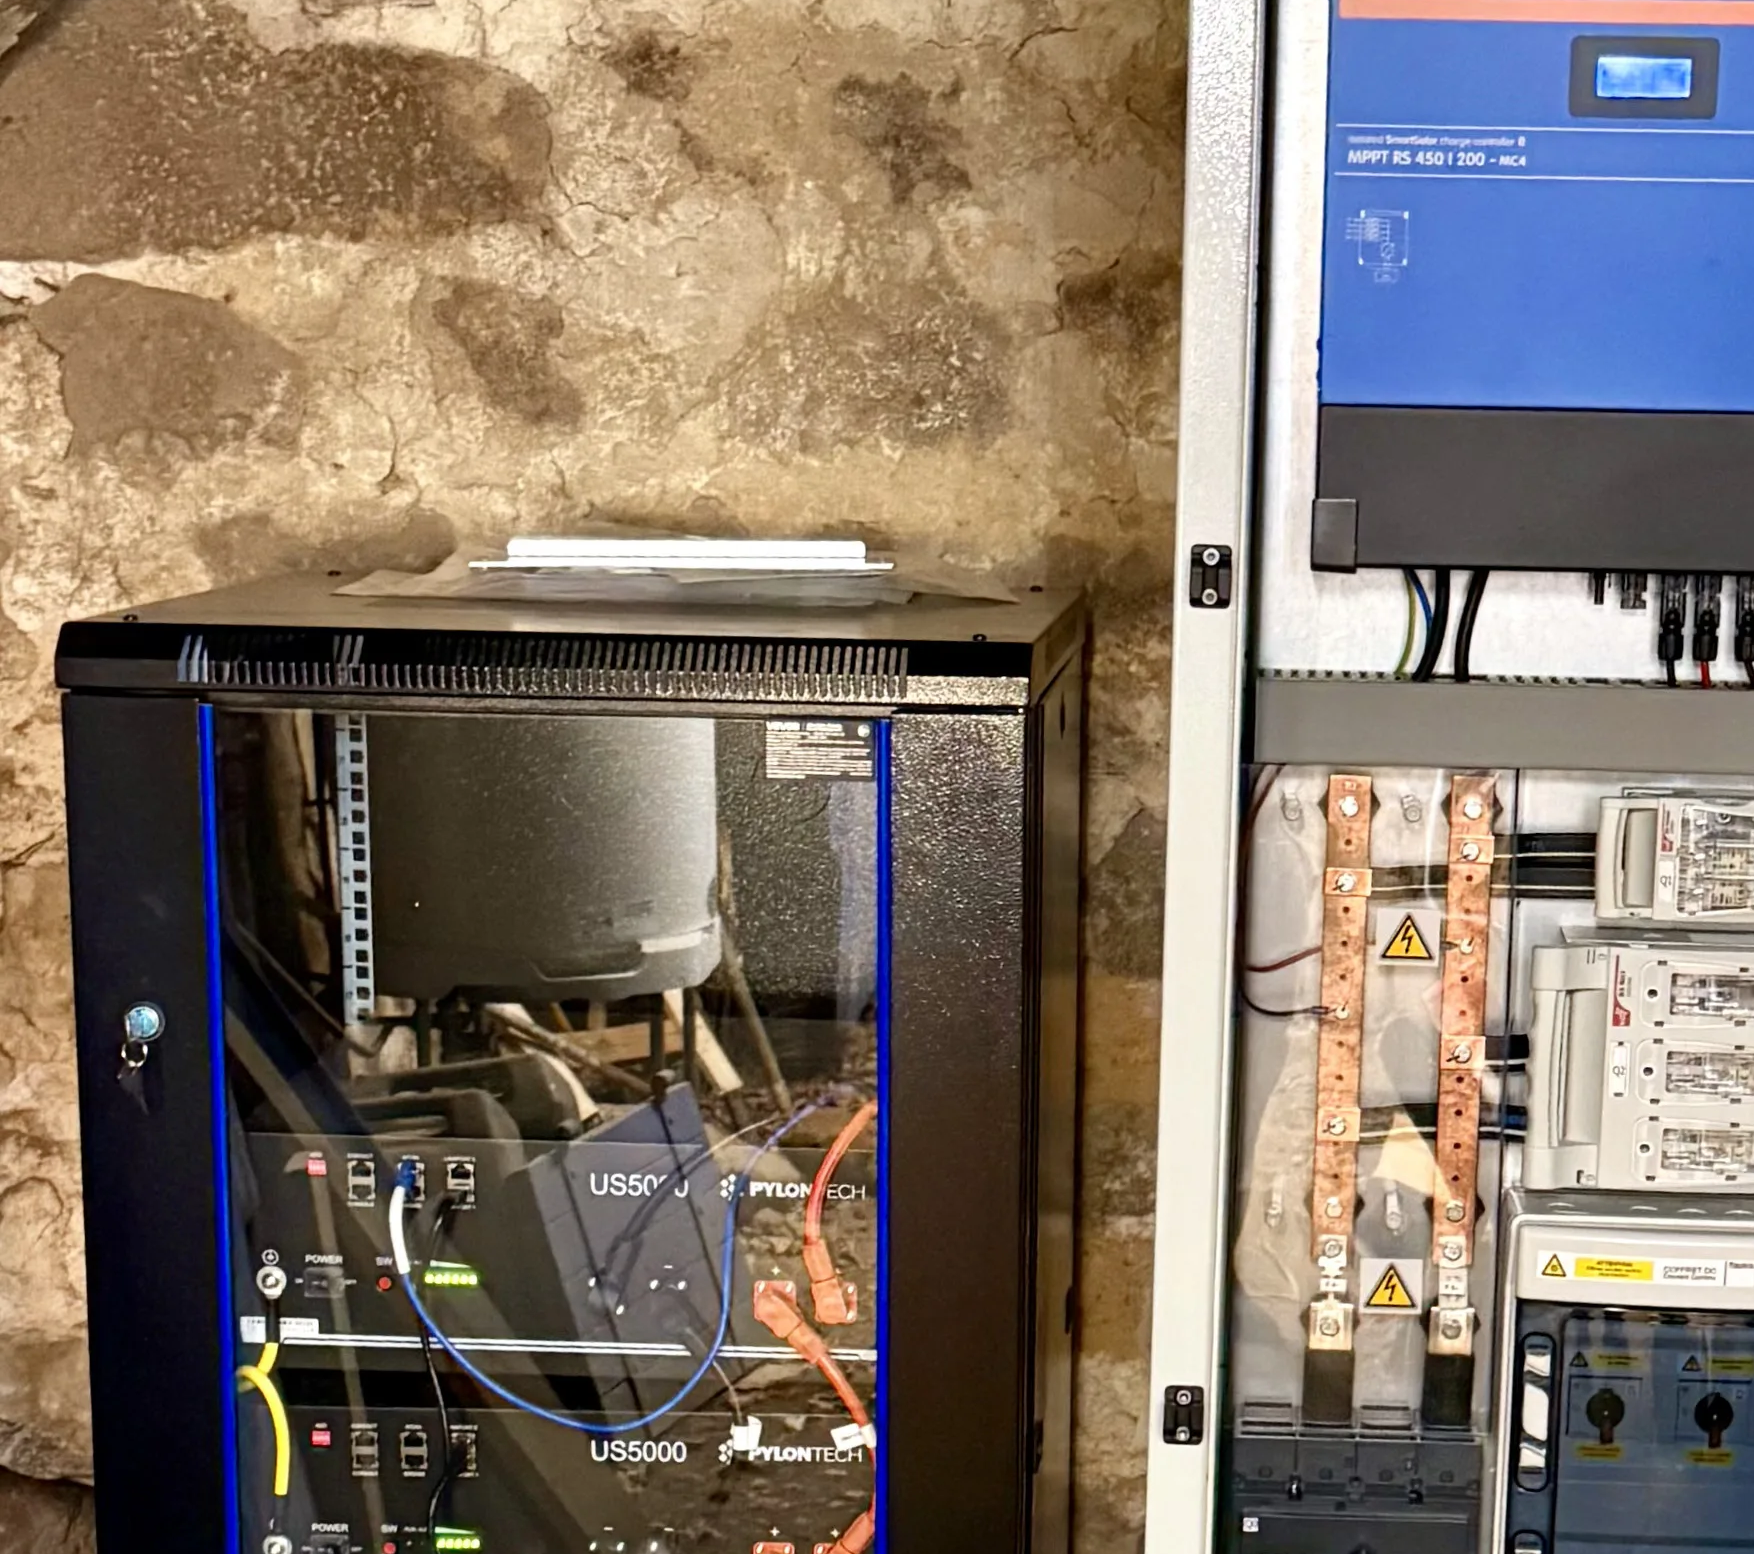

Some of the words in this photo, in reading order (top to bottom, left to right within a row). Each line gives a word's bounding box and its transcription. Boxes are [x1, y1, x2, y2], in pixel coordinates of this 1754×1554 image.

[1347, 150, 1389, 164] MPPT
[1393, 151, 1411, 165] RS
[1415, 152, 1444, 165] 450
[1457, 152, 1485, 166] 200
[749, 1181, 866, 1200] PYLONECH
[305, 1254, 343, 1265] POWER
[590, 1440, 687, 1463] US5000
[311, 1522, 349, 1533] POWER
[381, 1524, 398, 1533] SW
